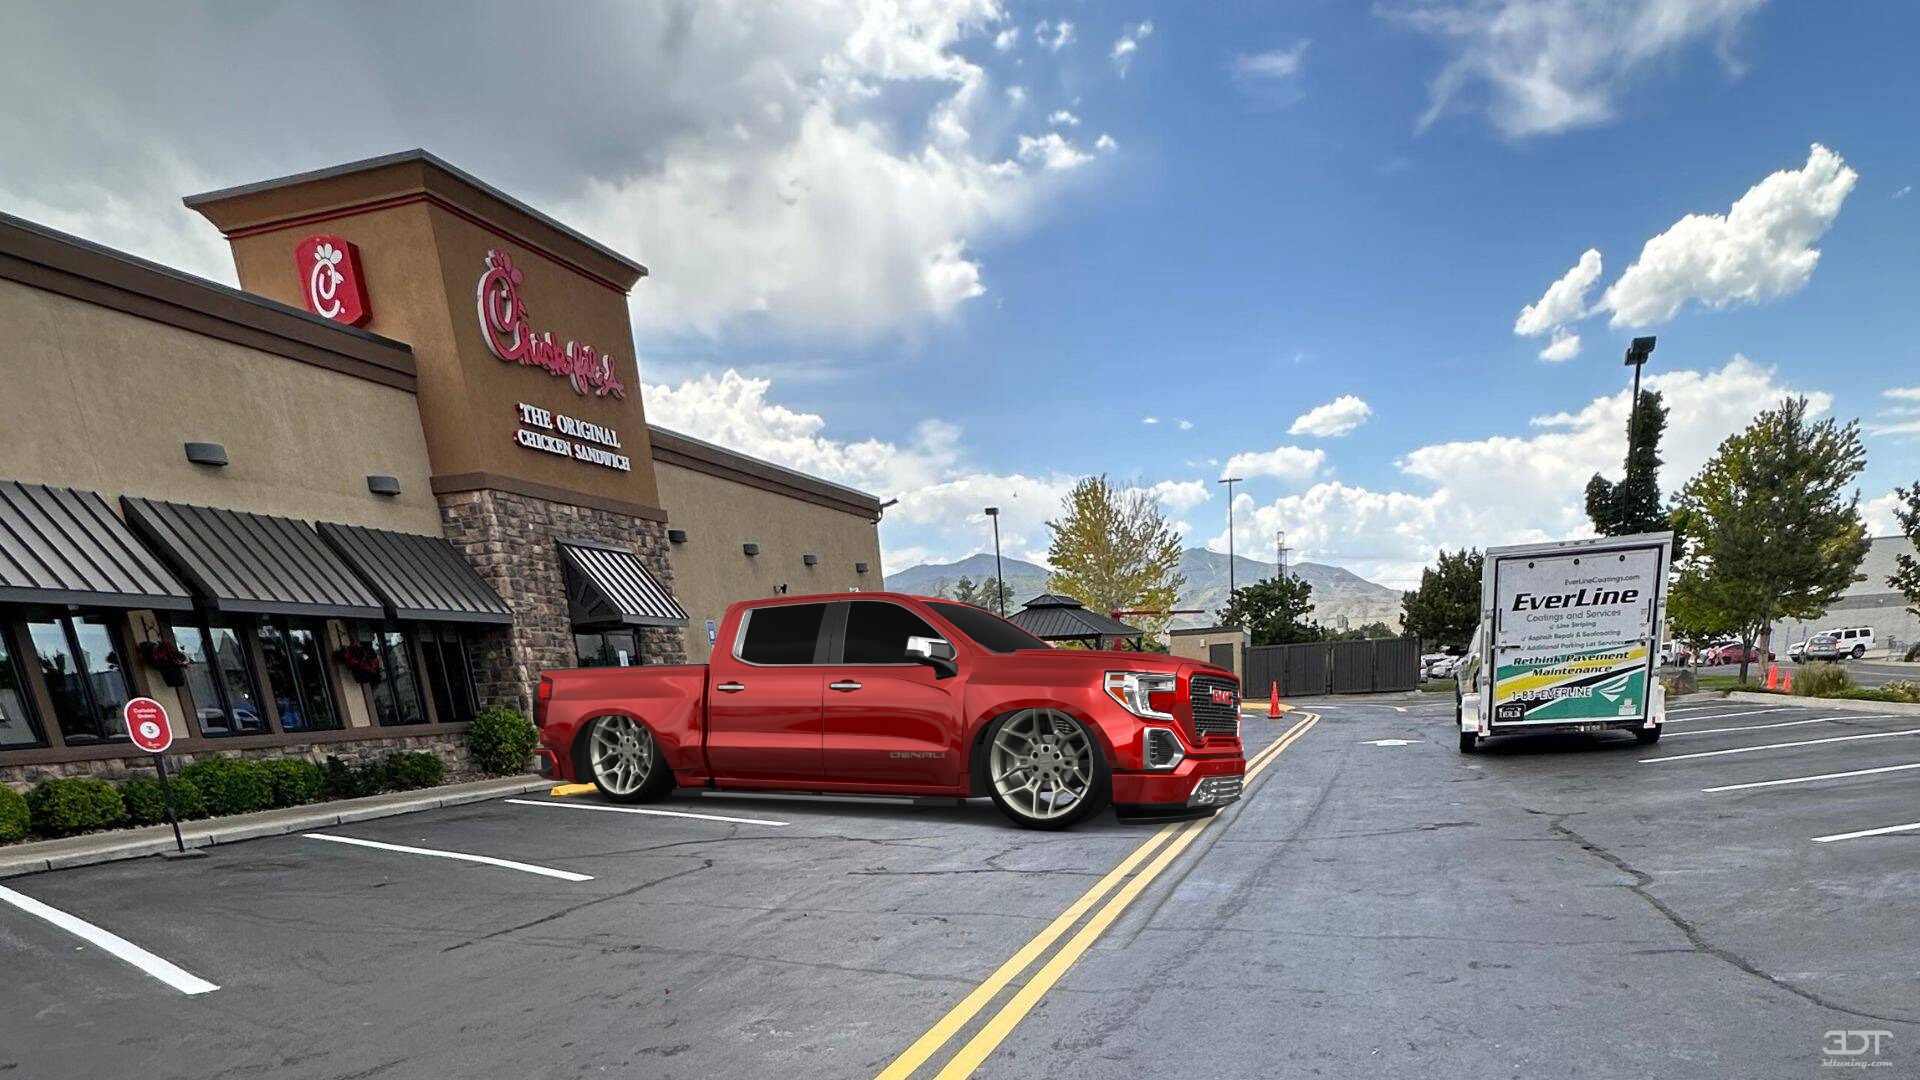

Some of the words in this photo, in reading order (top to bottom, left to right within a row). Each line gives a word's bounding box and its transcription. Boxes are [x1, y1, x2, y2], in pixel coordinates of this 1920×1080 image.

[518, 402, 553, 430] THE
[556, 414, 621, 449] ORIGINAL
[517, 429, 573, 457] CHICKEN
[574, 443, 631, 471] SANDWICH
[1564, 574, 1640, 586] EverLineCoatings.com
[1511, 587, 1639, 612] EverLine
[1526, 613, 1564, 622] Coatings
[1566, 611, 1584, 620] and
[1586, 609, 1622, 618] Services
[1554, 632, 1575, 640] Repair
[1560, 641, 1585, 649] Parking
[1513, 654, 1561, 666] Rethink
[1565, 651, 1630, 662] Pavement
[1532, 665, 1613, 677] Maintenance
[1212, 689, 1233, 706] GMC
[145, 725, 154, 734] 3
[889, 751, 946, 759] DENALI
